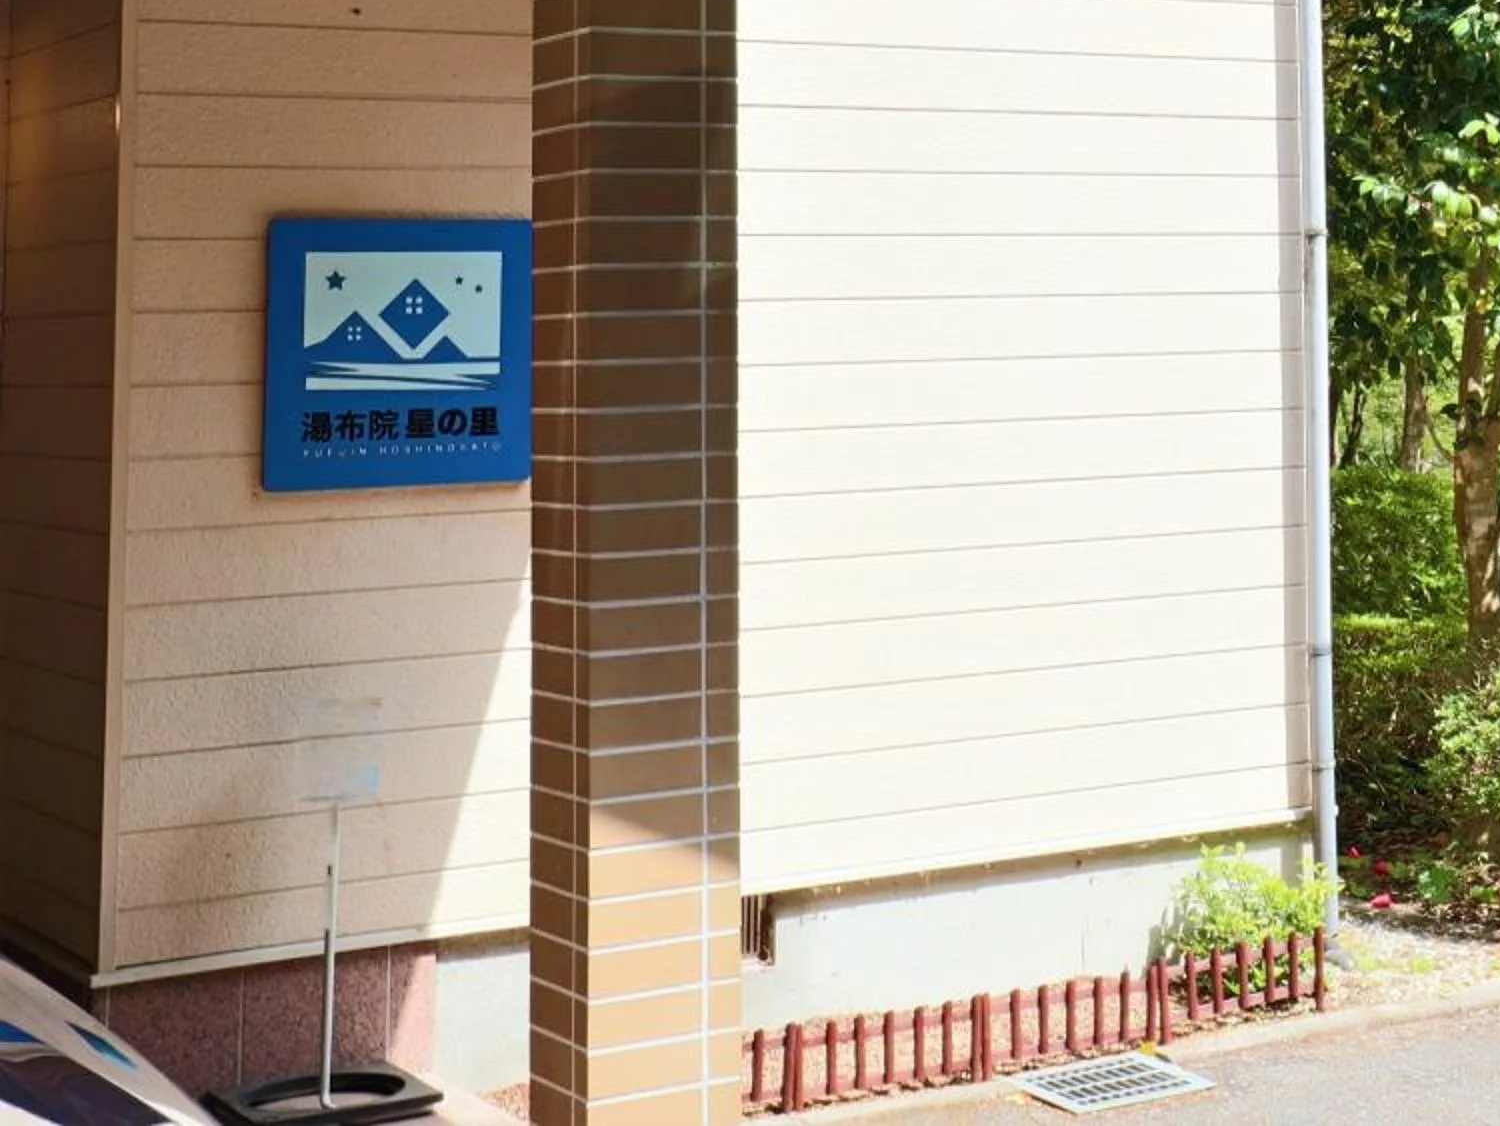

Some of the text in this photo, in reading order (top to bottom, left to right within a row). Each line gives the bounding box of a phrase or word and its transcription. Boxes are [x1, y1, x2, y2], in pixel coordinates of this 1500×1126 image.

[301, 406, 500, 443] 湯布院 星の里
